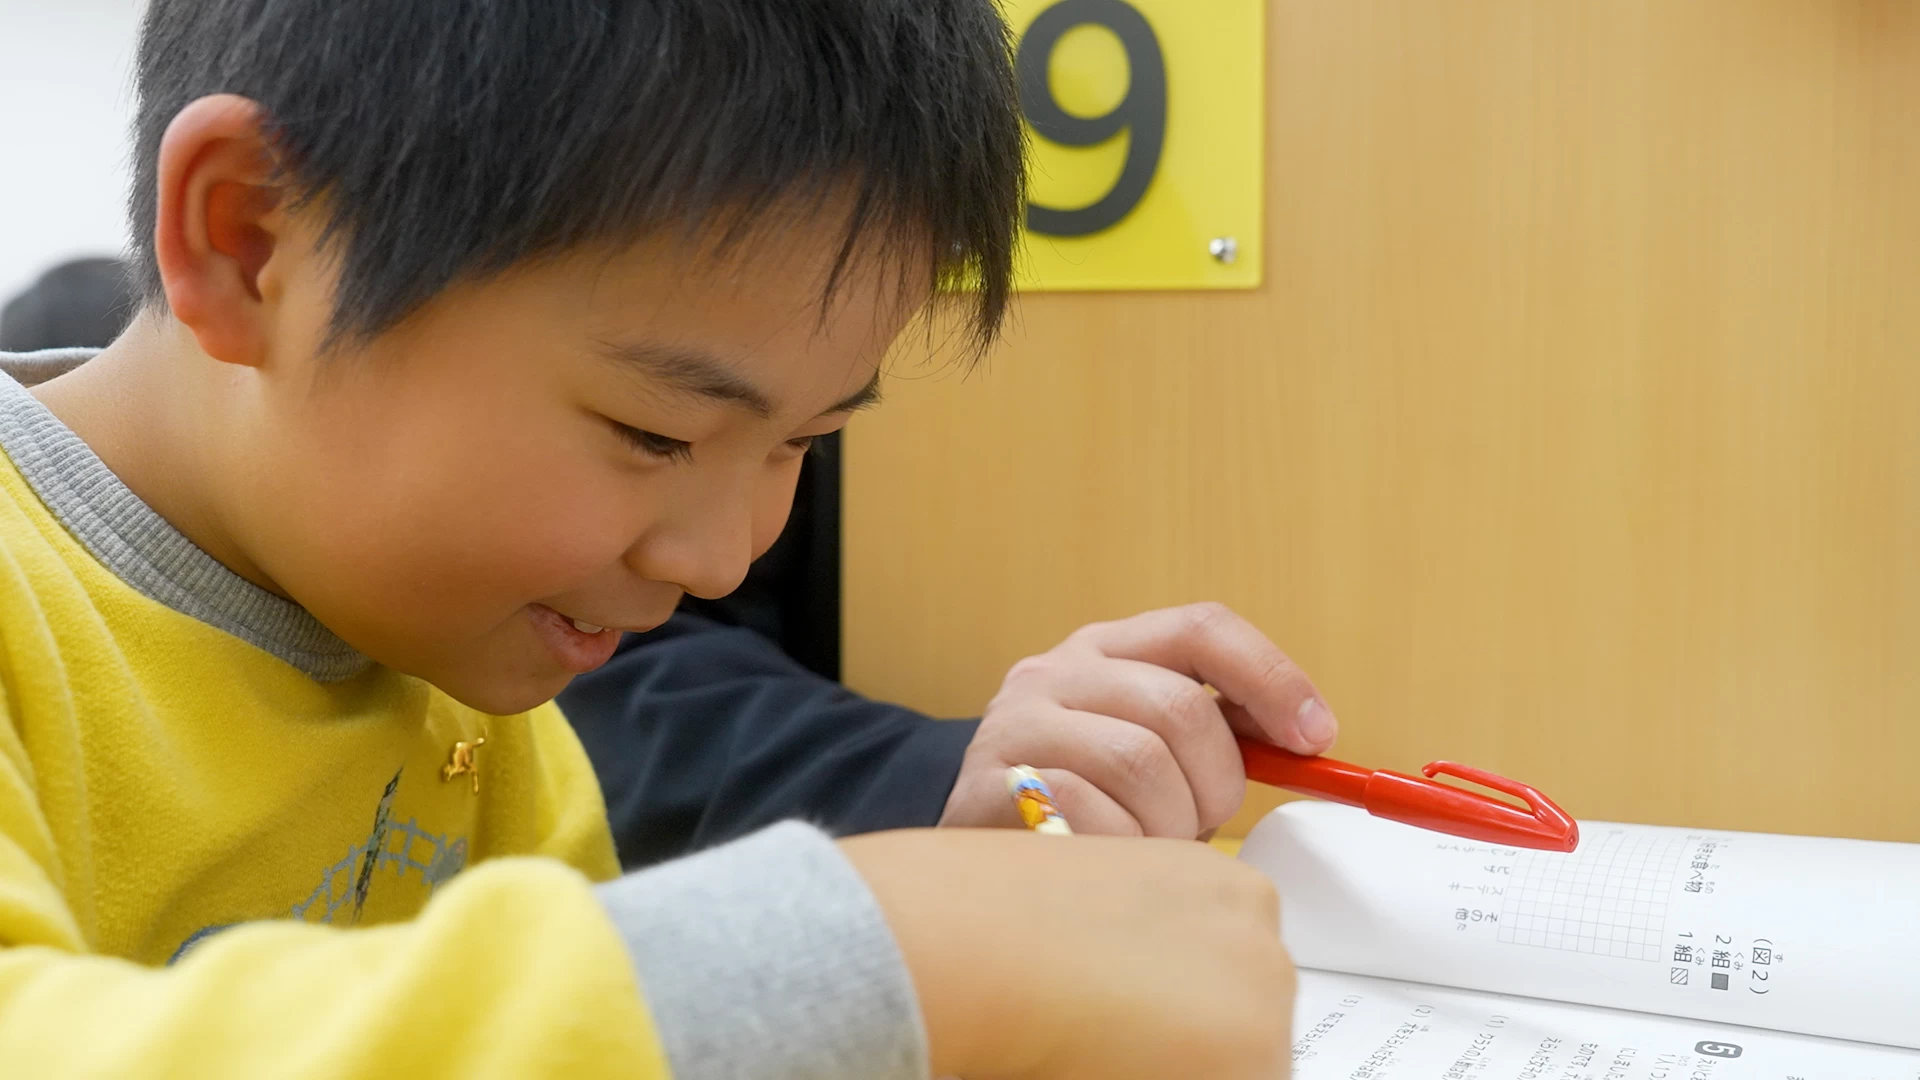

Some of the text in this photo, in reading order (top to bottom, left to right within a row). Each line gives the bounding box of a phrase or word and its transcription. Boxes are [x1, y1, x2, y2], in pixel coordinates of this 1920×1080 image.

[1014, 0, 1168, 238] 9
[1455, 908, 1499, 923] その他
[1338, 994, 1364, 1008] (3)
[1411, 1004, 1435, 1018] (2)
[1484, 1015, 1509, 1028] (1)
